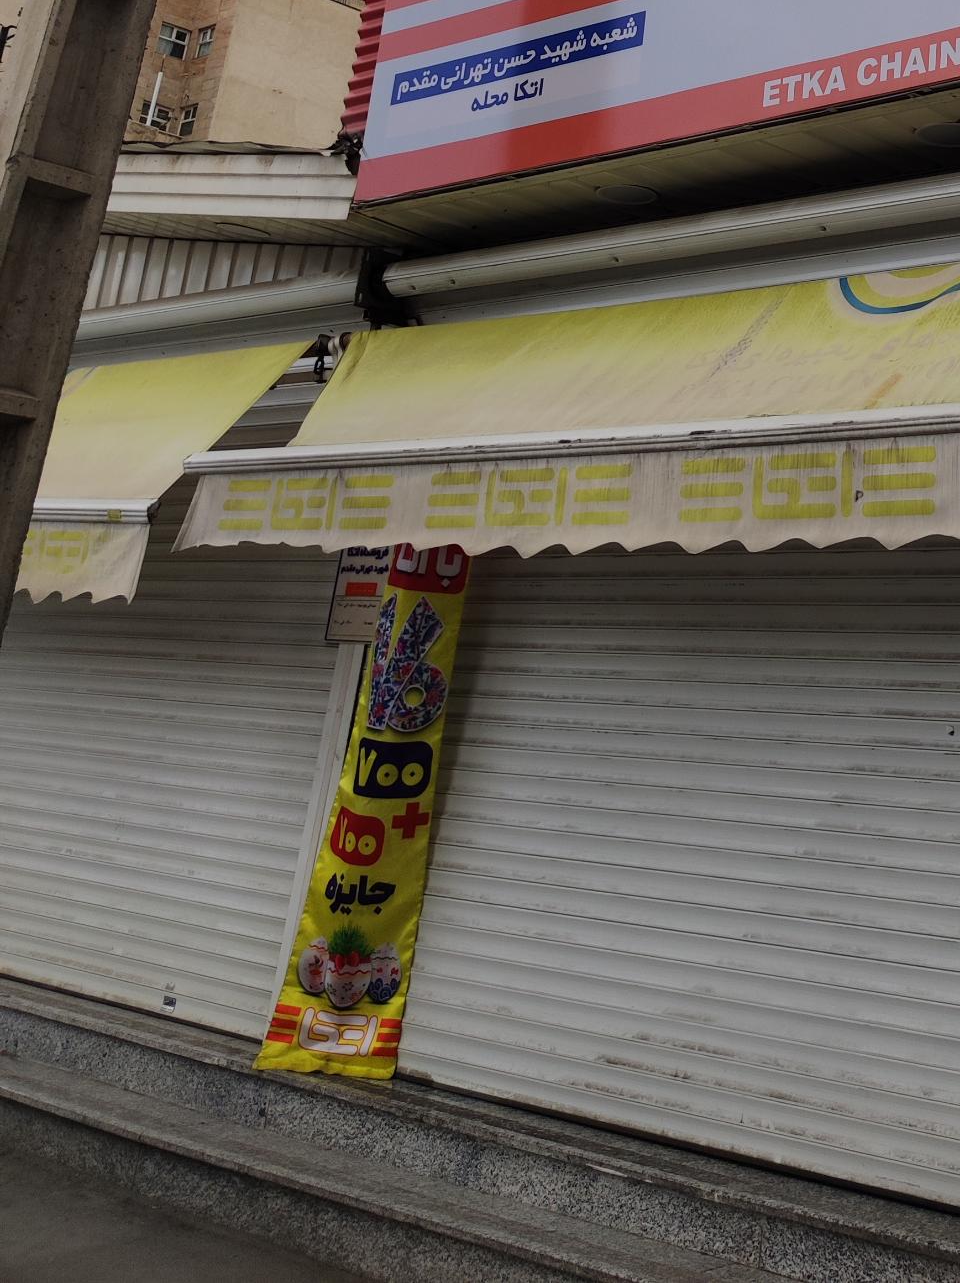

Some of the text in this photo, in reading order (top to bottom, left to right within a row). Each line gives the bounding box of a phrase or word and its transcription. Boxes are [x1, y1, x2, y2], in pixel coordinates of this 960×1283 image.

[397, 17, 638, 100] شعبه شهید حسن تهرانی مقدم
[471, 78, 545, 112] اتکا محله
[762, 65, 846, 108] ETKA
[325, 872, 396, 915] جایزه
